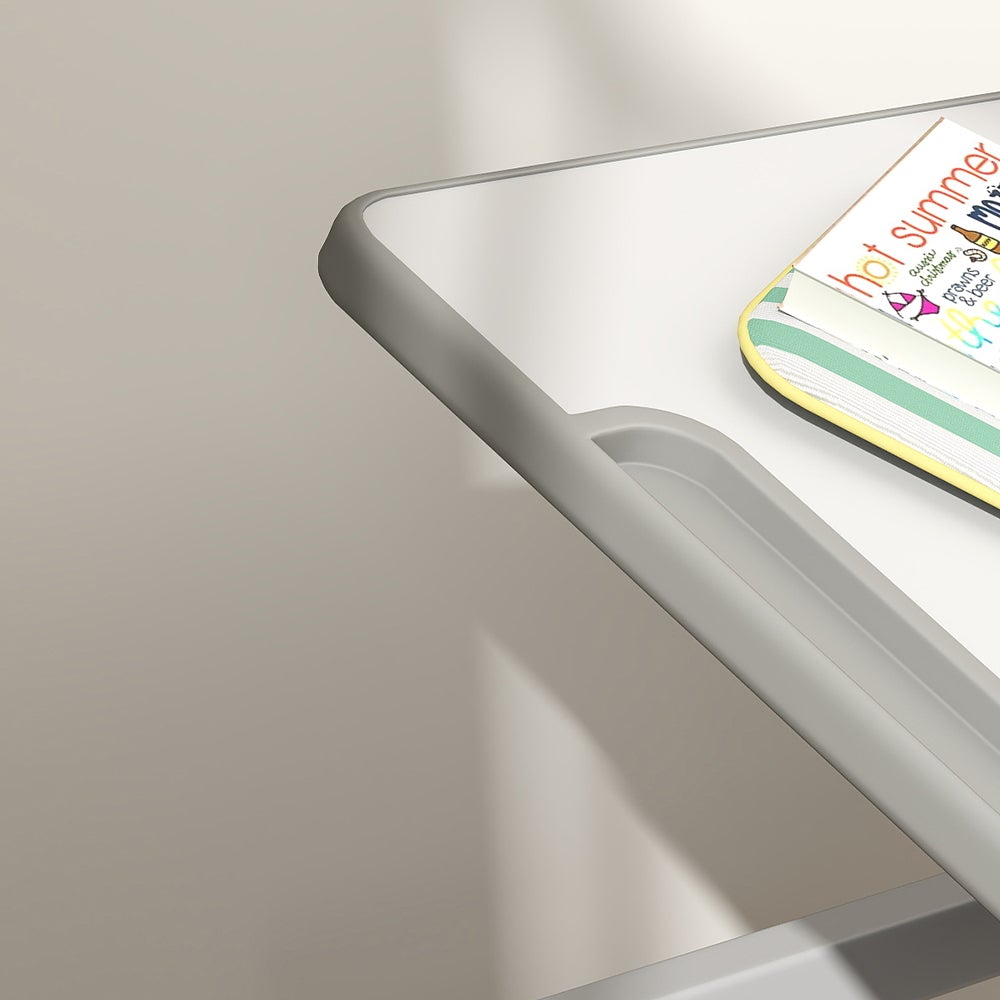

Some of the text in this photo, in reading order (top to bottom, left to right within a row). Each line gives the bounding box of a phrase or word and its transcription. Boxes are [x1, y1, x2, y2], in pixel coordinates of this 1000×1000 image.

[828, 243, 905, 298] hot
[942, 267, 980, 304] prawns
[966, 273, 996, 298] beer
